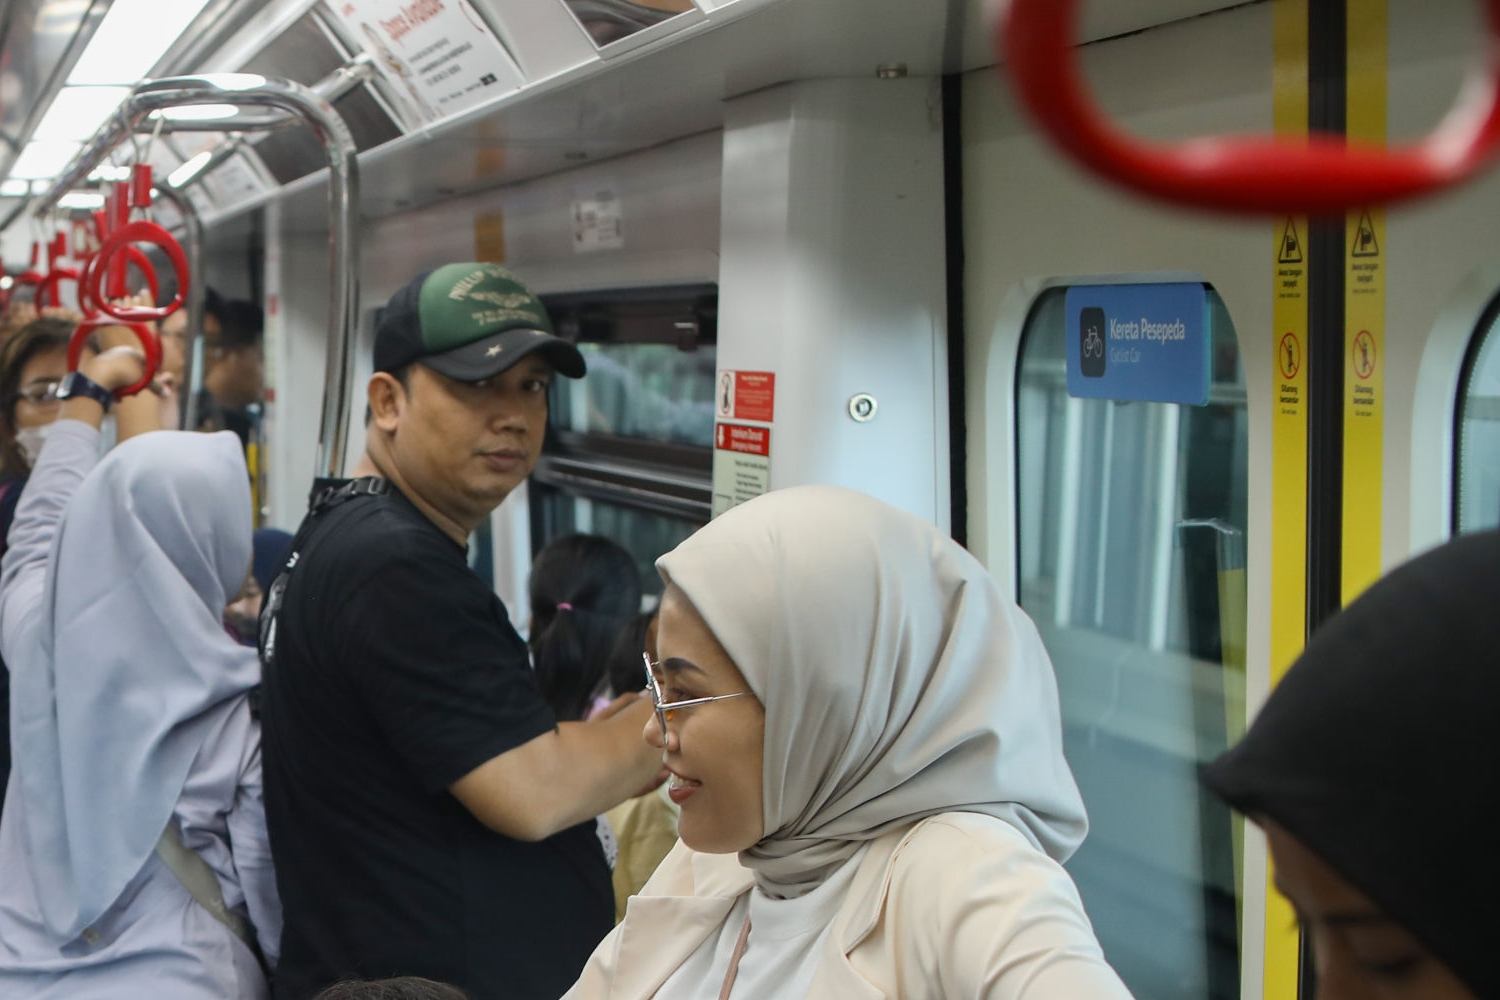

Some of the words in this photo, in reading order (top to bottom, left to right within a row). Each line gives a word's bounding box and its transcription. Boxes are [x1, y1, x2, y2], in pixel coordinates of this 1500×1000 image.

[1110, 318, 1139, 340] Kereta
[1141, 317, 1186, 345] Pesepeda
[1130, 348, 1141, 363] Car
